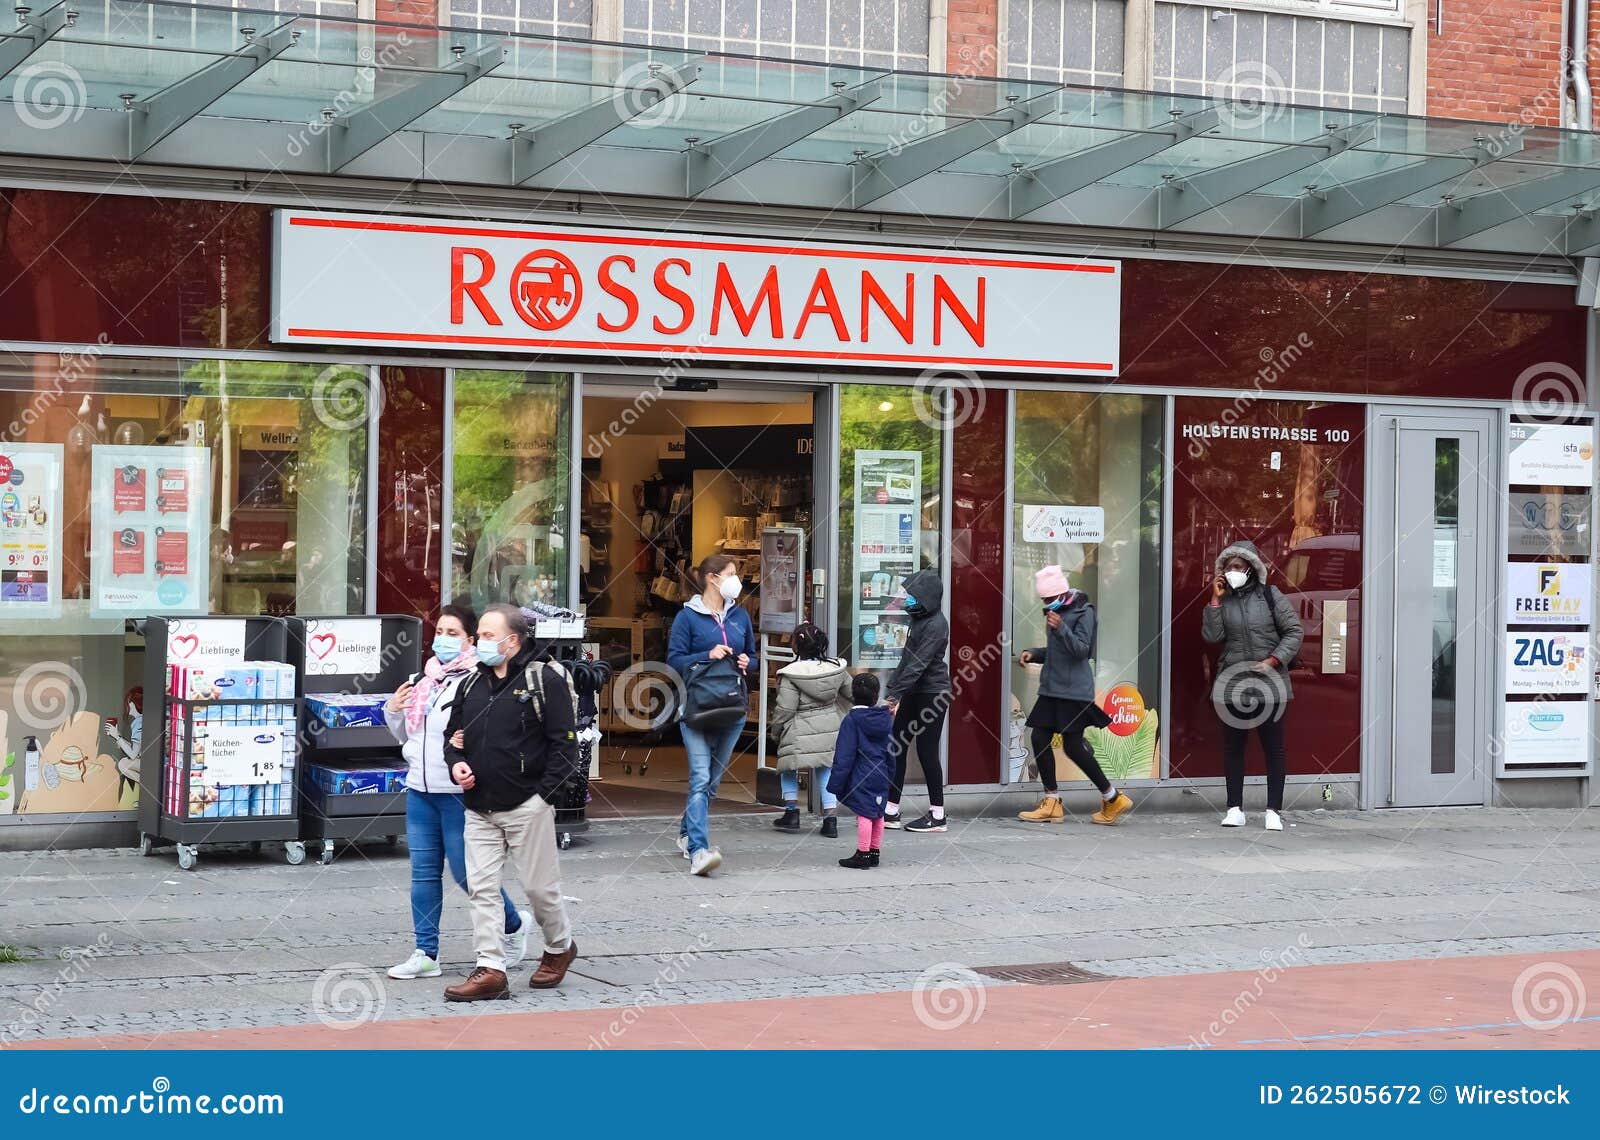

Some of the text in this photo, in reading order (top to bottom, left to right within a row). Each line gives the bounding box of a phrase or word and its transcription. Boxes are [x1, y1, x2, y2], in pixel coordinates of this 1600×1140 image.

[450, 246, 986, 348] ROSSMANN
[1324, 429, 1350, 443] 100
[1516, 597, 1581, 611] FREEWAY
[201, 645, 240, 656] Lieblinge
[338, 643, 377, 654] Lieblinge
[1513, 638, 1564, 666] ZAG
[212, 739, 243, 747] Küchen-
[212, 748, 236, 757] tücher
